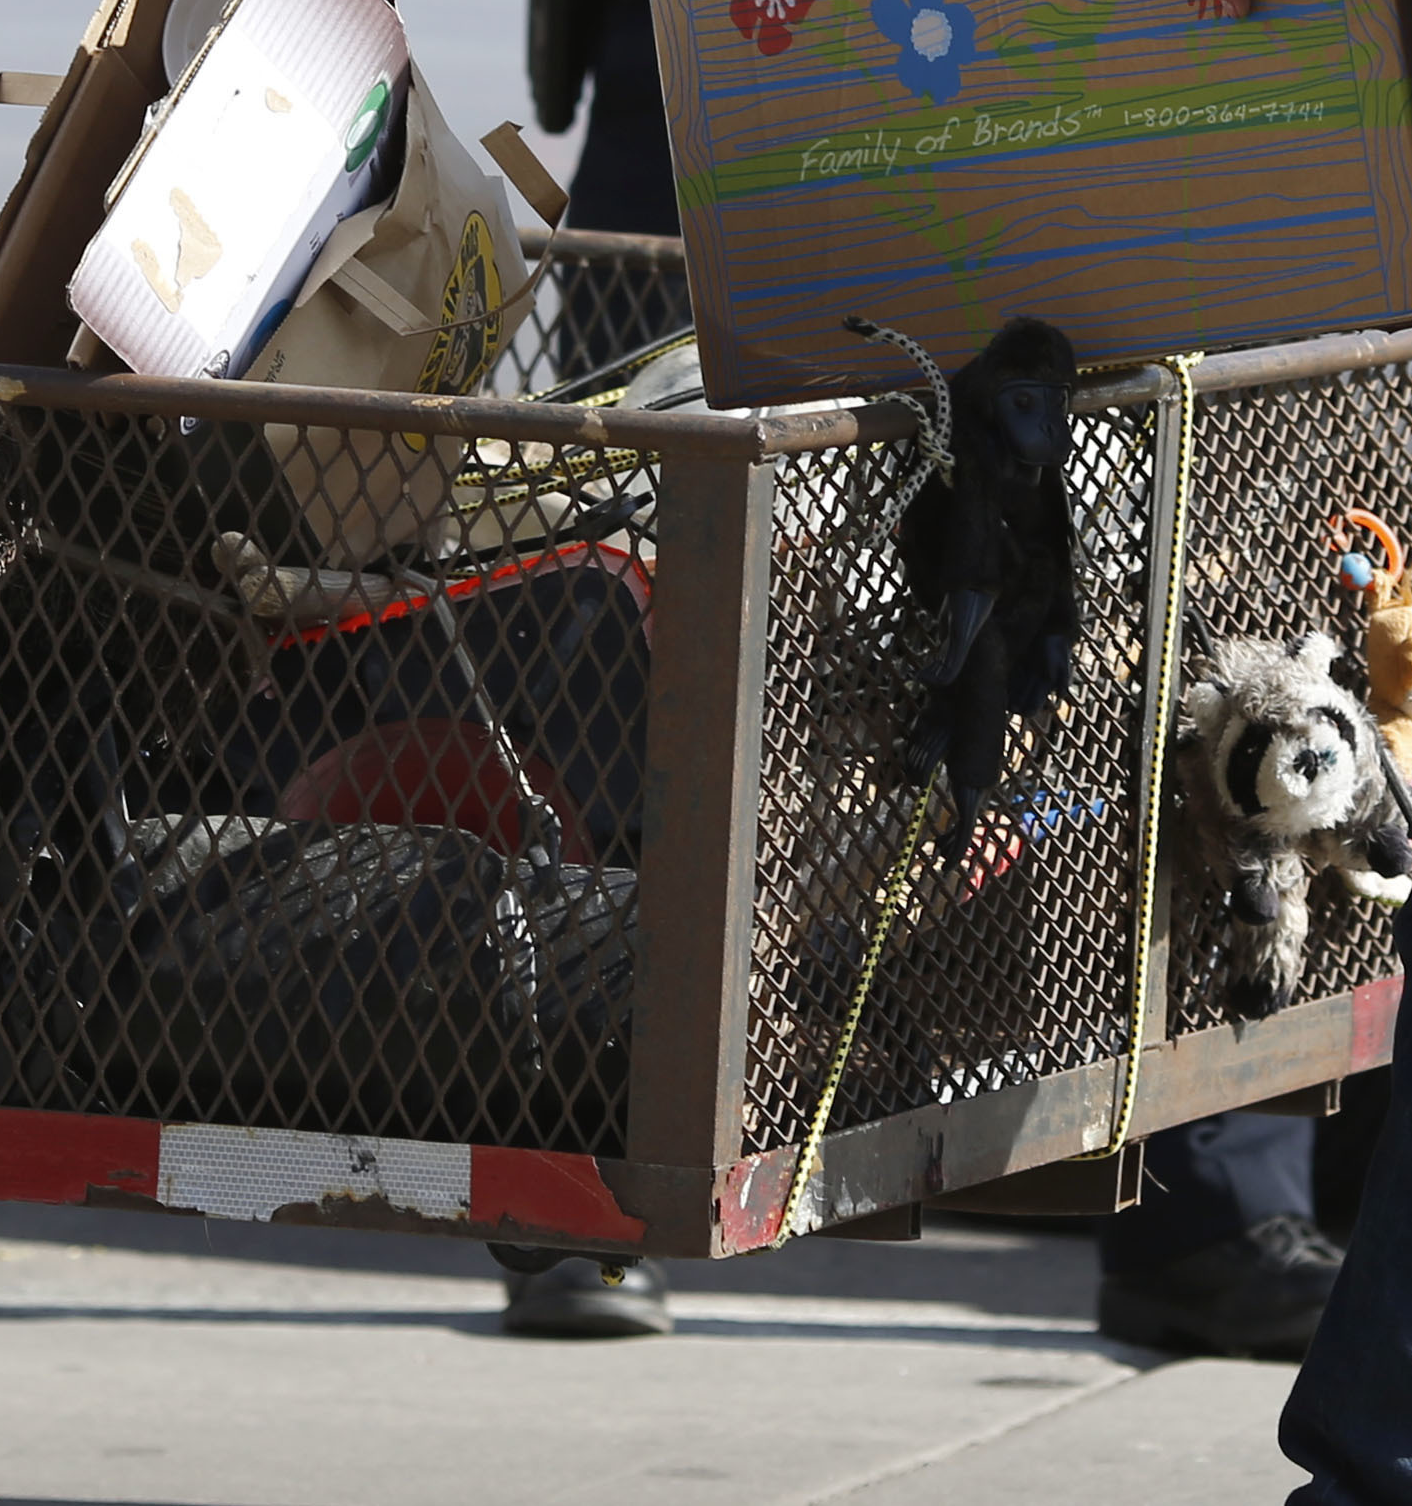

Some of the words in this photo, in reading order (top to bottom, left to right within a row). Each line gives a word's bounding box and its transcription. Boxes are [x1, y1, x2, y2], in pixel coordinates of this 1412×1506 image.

[798, 128, 898, 181] Family
[915, 116, 960, 156] of
[1123, 100, 1325, 128] 1-800-864-7744
